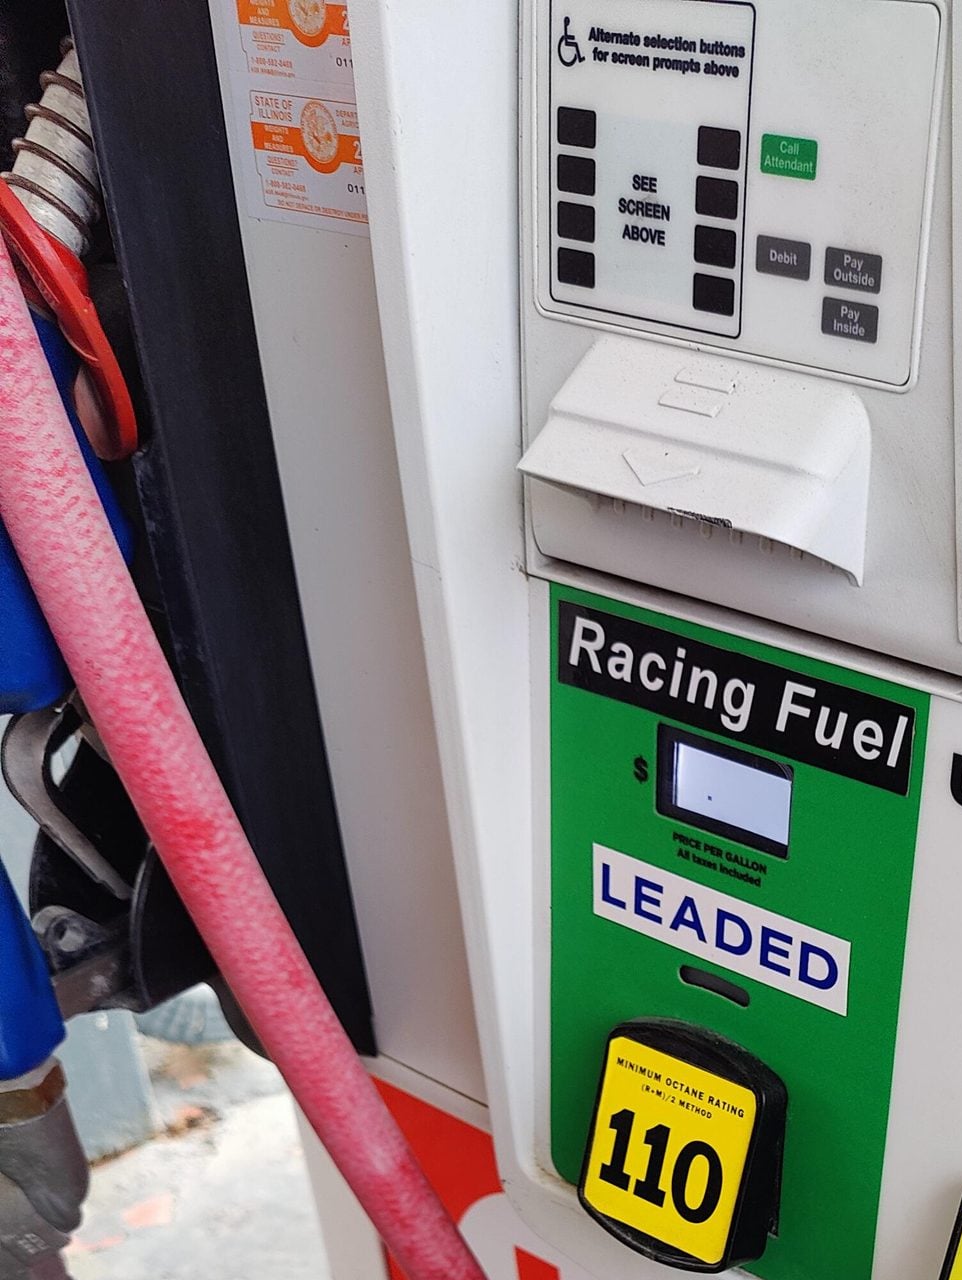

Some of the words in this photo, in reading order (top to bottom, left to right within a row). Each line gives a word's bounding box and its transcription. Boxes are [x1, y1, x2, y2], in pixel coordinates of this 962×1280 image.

[588, 27, 641, 46] Alternate
[643, 34, 696, 53] selection
[700, 38, 746, 58] buttons
[593, 47, 609, 63] for
[611, 51, 650, 68] screen
[653, 55, 701, 74] prompts
[703, 61, 740, 78] above
[255, 95, 280, 109] STATE
[281, 99, 293, 110] OF
[258, 108, 293, 122] ILLINOIS
[779, 140, 800, 156] Call
[763, 157, 814, 174] Attendant
[632, 174, 657, 193] SEE
[618, 197, 671, 222] SCREEN
[622, 224, 666, 246] ABOVE
[769, 249, 798, 266] Debit
[843, 254, 864, 270] Pay
[833, 268, 875, 287] Outside
[840, 305, 861, 321] Pay
[833, 319, 866, 337] Inside
[567, 615, 755, 732] Racing
[775, 680, 909, 768] Fuel
[633, 755, 649, 784] $
[672, 831, 702, 850] PRICE
[703, 843, 723, 858] PER
[725, 852, 768, 875] GALLON
[677, 847, 690, 860] All
[692, 853, 718, 871] taxes
[602, 863, 838, 990] LEADED
[617, 1056, 662, 1083] MINIMUM
[665, 1077, 705, 1101] OCTANE
[707, 1095, 745, 1118] RATING
[678, 1099, 713, 1119] METHOD
[598, 1108, 723, 1224] 110
